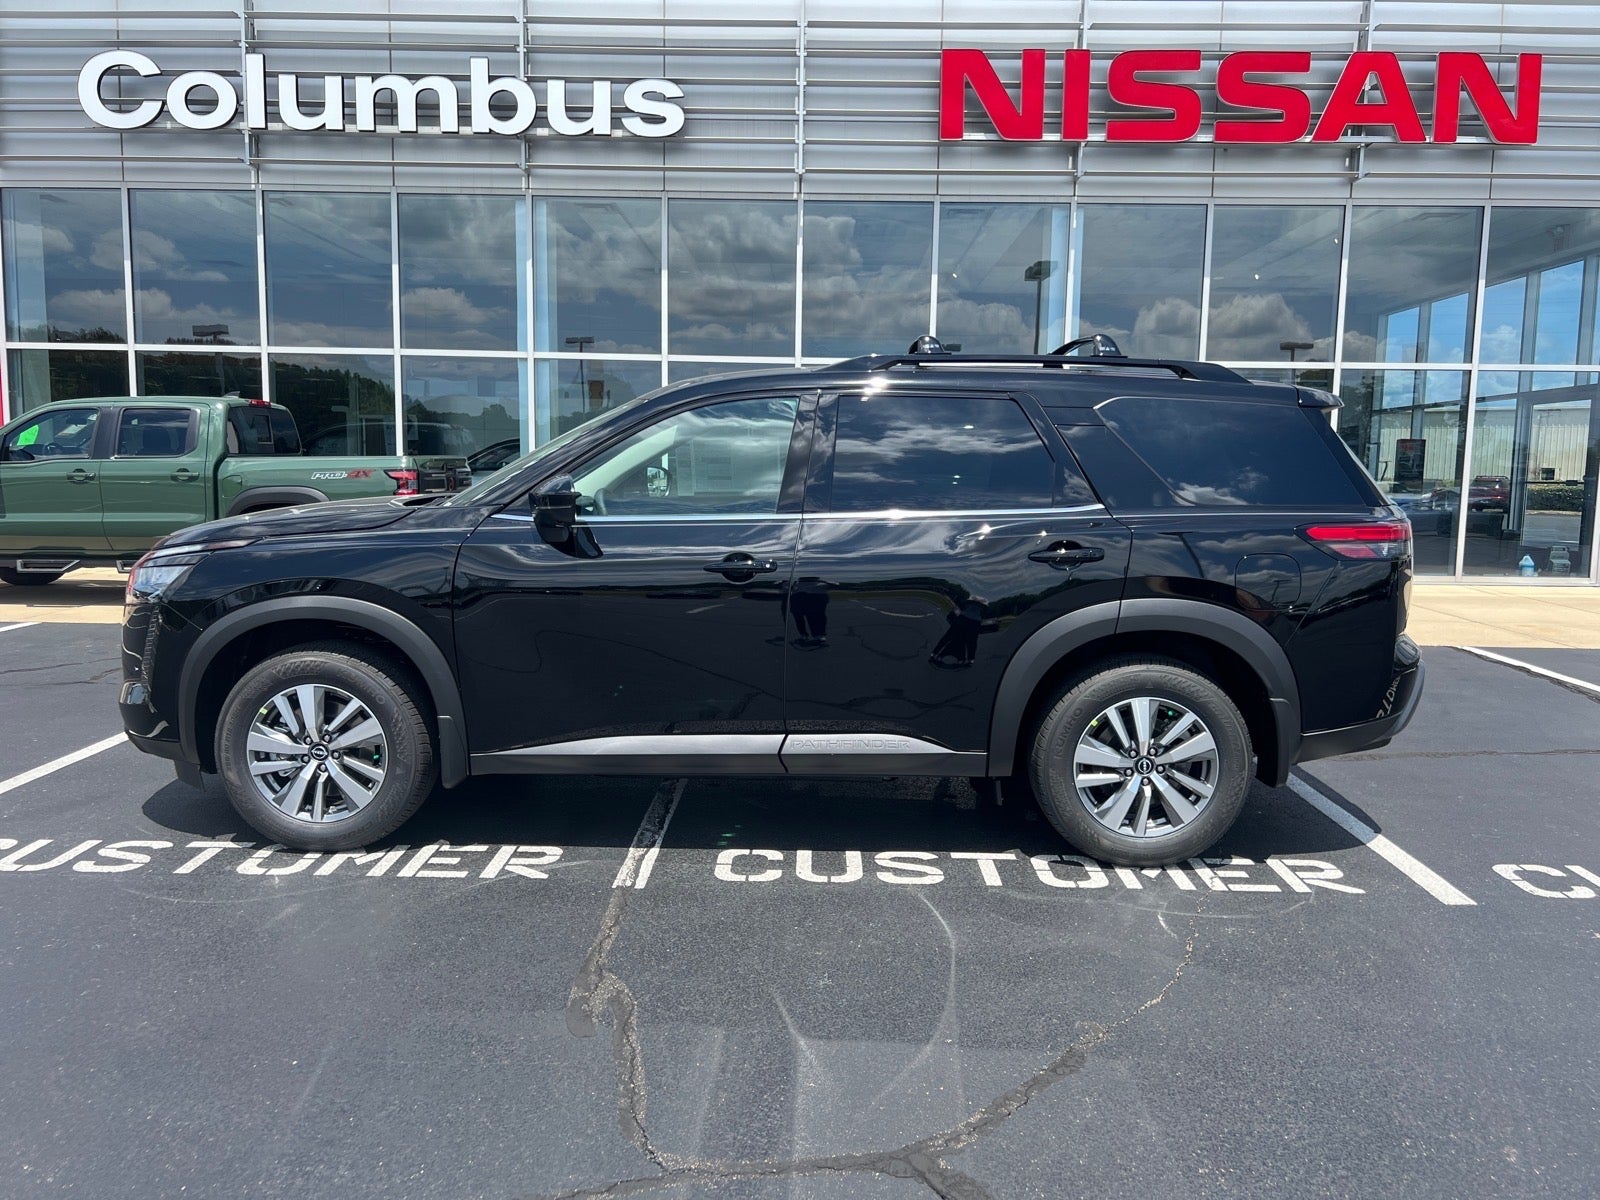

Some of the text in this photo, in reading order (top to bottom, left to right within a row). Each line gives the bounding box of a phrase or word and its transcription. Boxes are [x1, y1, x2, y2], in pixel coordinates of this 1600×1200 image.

[77, 49, 685, 137] Columbus
[939, 48, 1543, 145] NISSAN
[789, 739, 911, 750] PATHFINDER
[0, 839, 564, 879] USTOMER
[714, 848, 1366, 894] CUSTOMER
